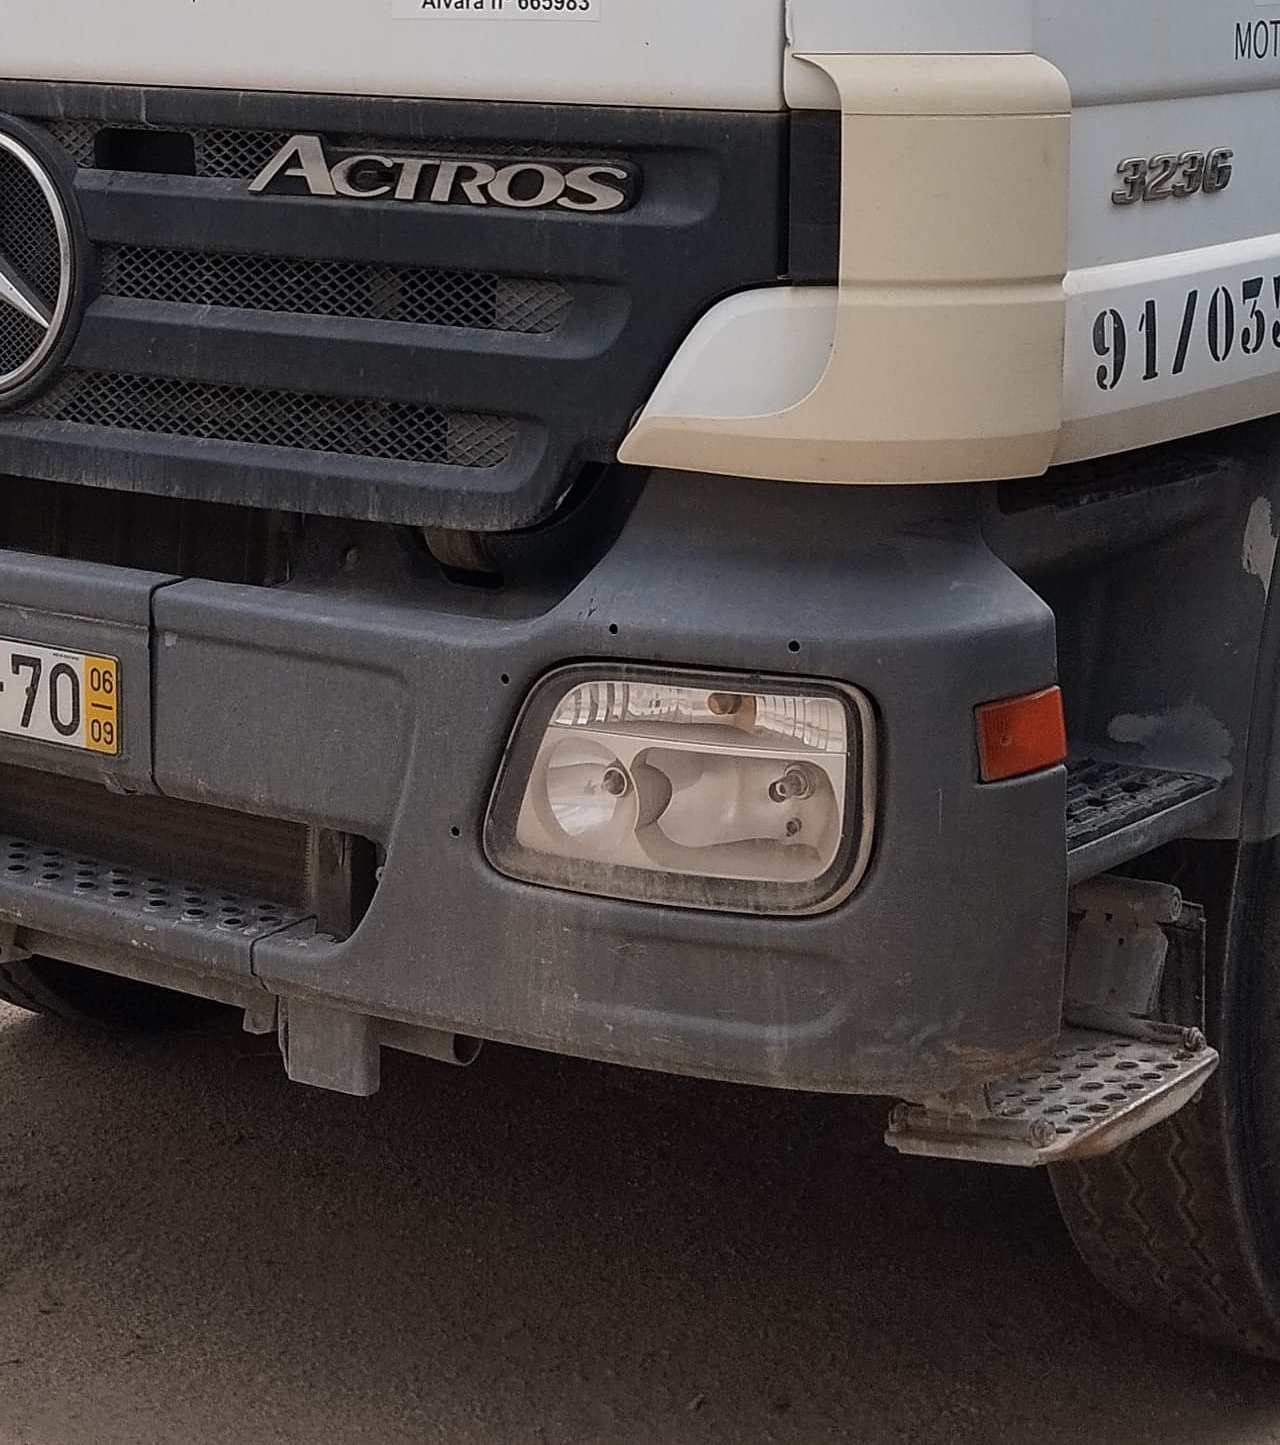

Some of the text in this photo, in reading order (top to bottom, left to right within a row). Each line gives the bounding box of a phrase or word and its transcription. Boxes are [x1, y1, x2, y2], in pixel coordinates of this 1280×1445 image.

[1111, 146, 1234, 206] 3236
[90, 667, 114, 695] 06
[90, 719, 114, 745] 09
